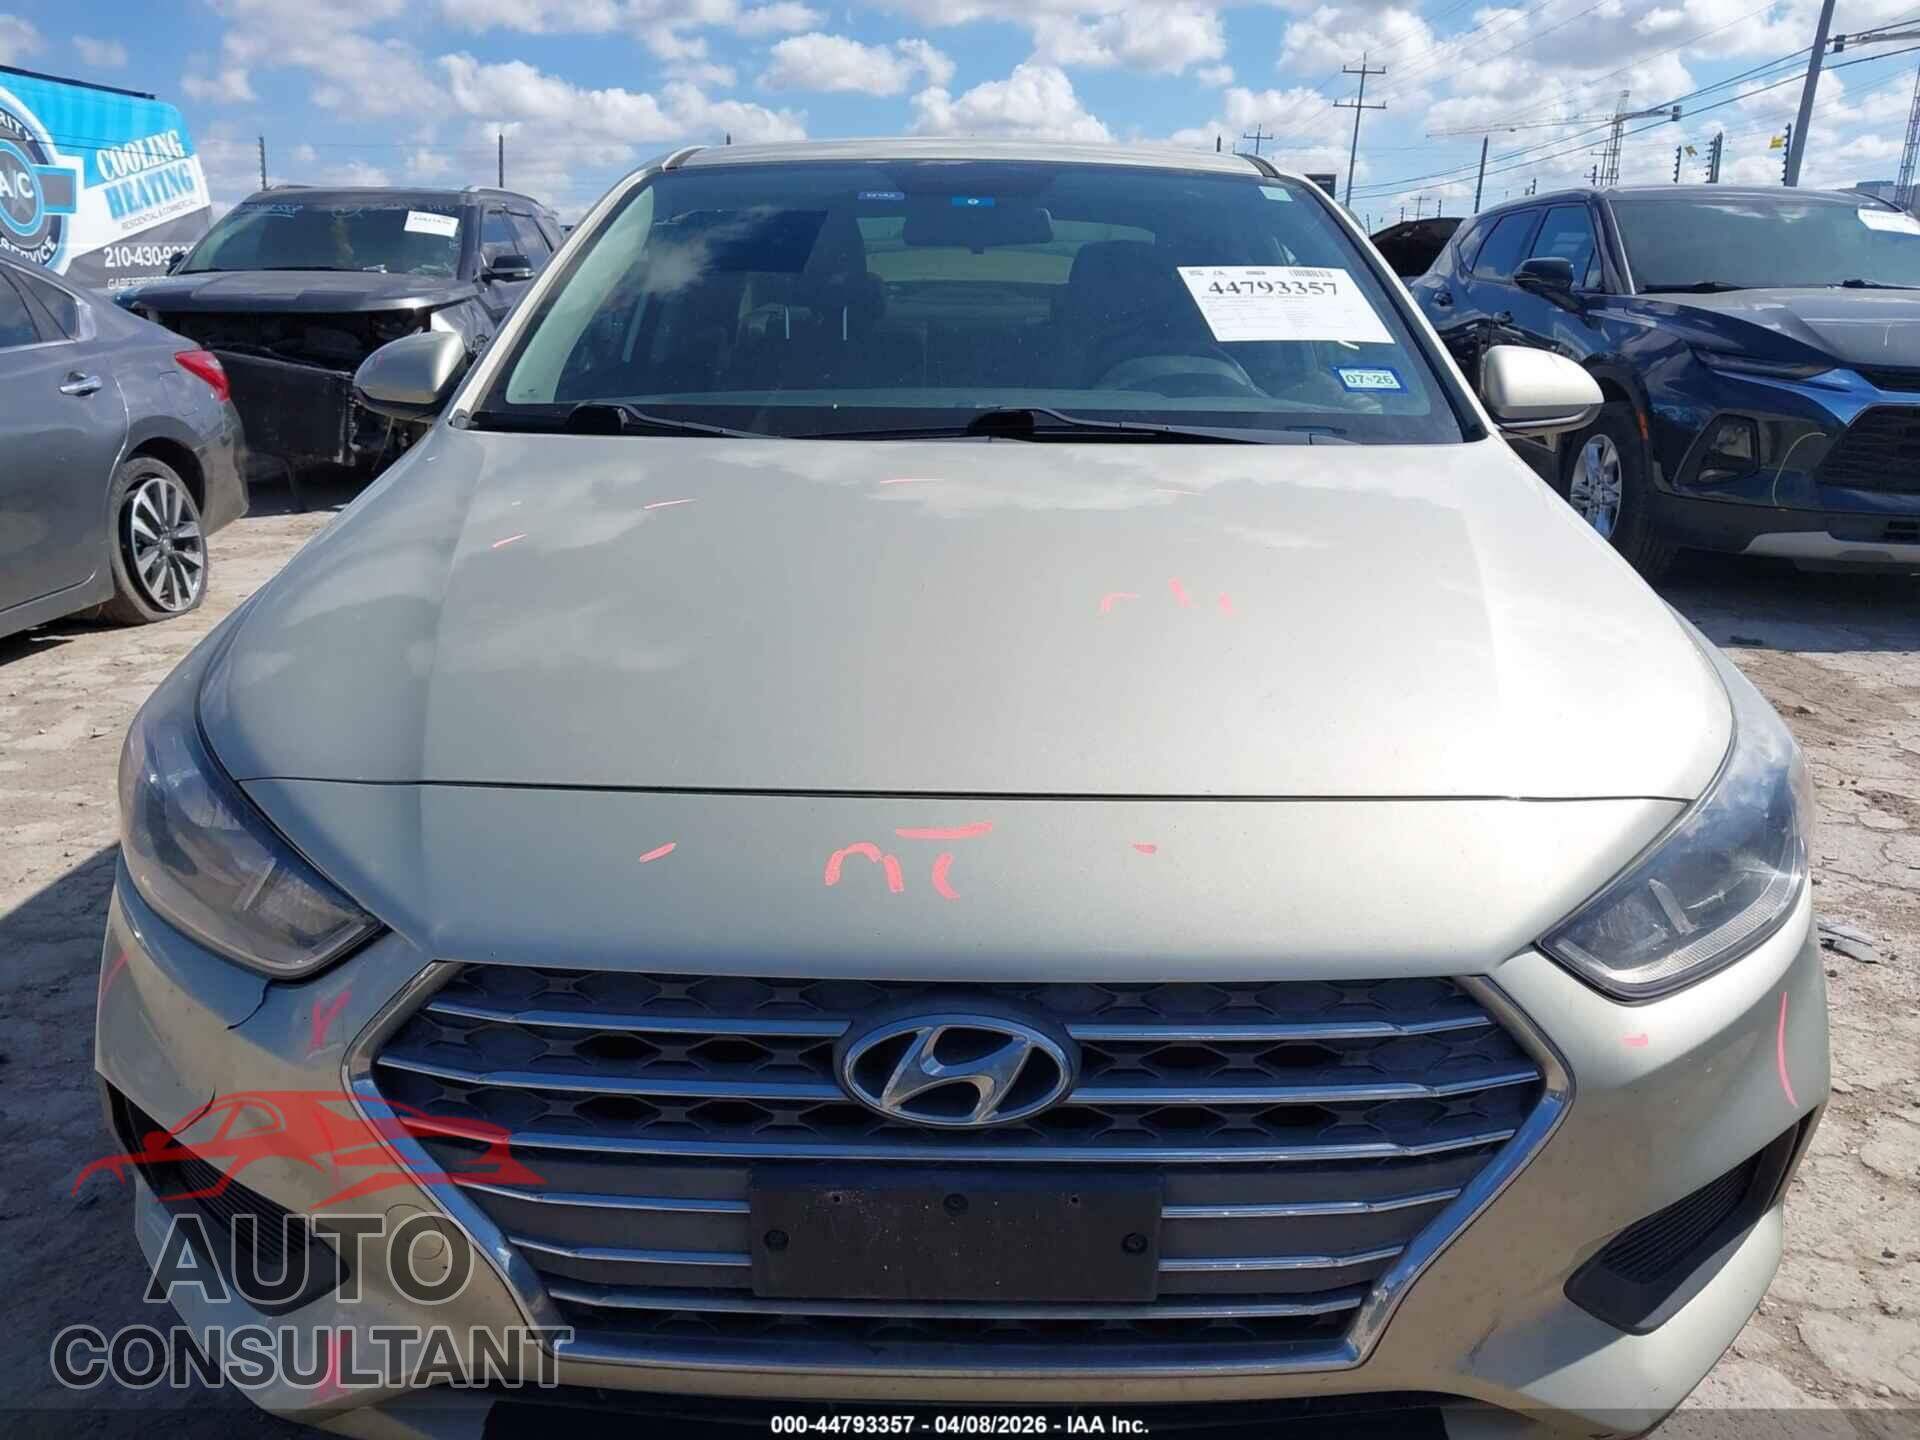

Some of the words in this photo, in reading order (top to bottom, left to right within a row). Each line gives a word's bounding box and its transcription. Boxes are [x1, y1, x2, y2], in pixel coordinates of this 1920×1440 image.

[96, 129, 186, 181] COOLING
[104, 163, 195, 220] HEATING
[104, 246, 193, 268] 210-430-9
[1208, 280, 1338, 296] 44793357
